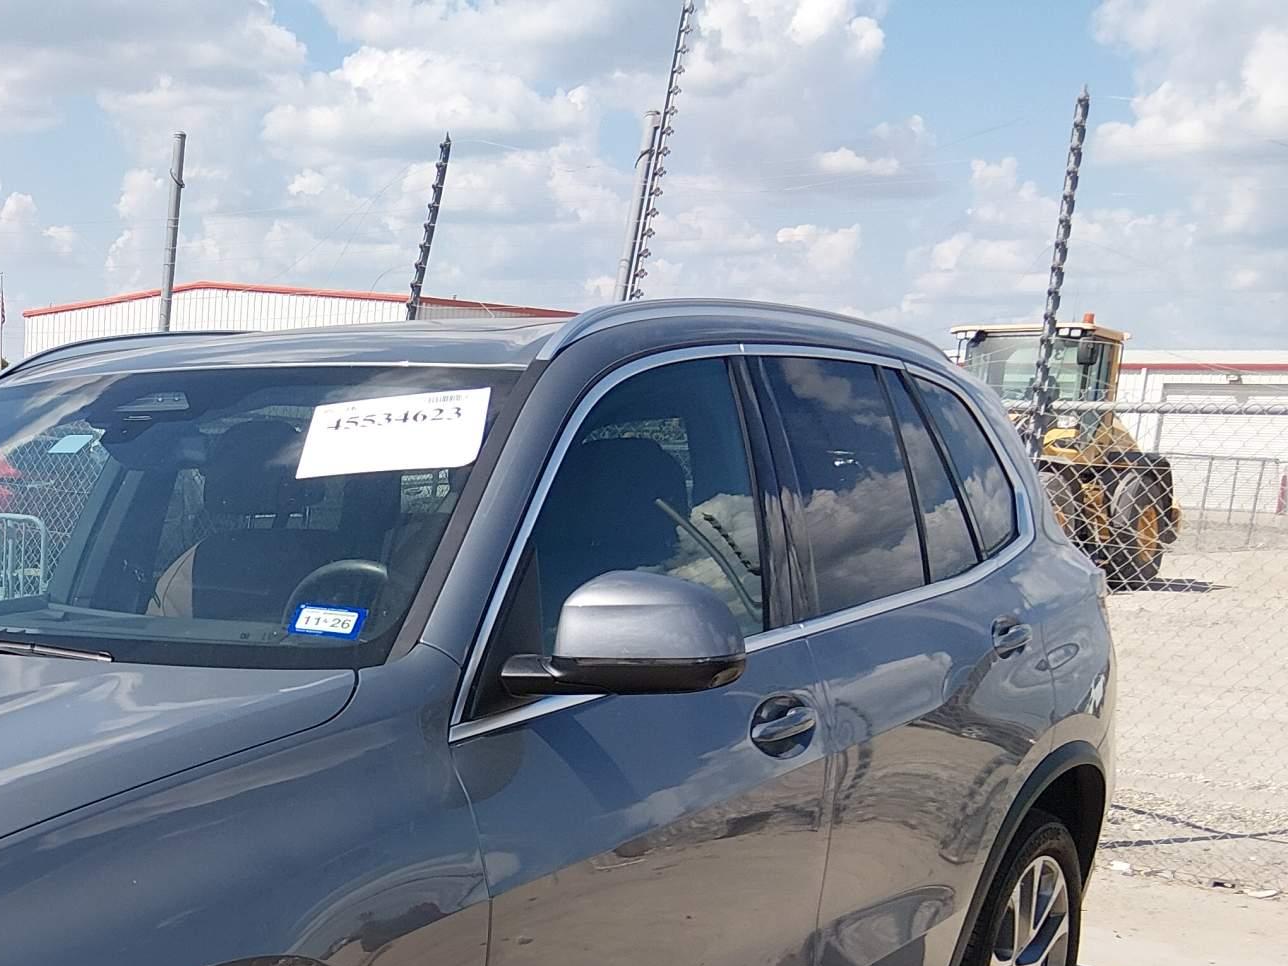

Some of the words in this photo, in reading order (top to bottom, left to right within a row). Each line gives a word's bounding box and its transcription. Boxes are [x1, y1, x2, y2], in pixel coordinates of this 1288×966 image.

[327, 406, 462, 431] 45534623
[304, 615, 321, 626] 11
[330, 617, 352, 630] 26
